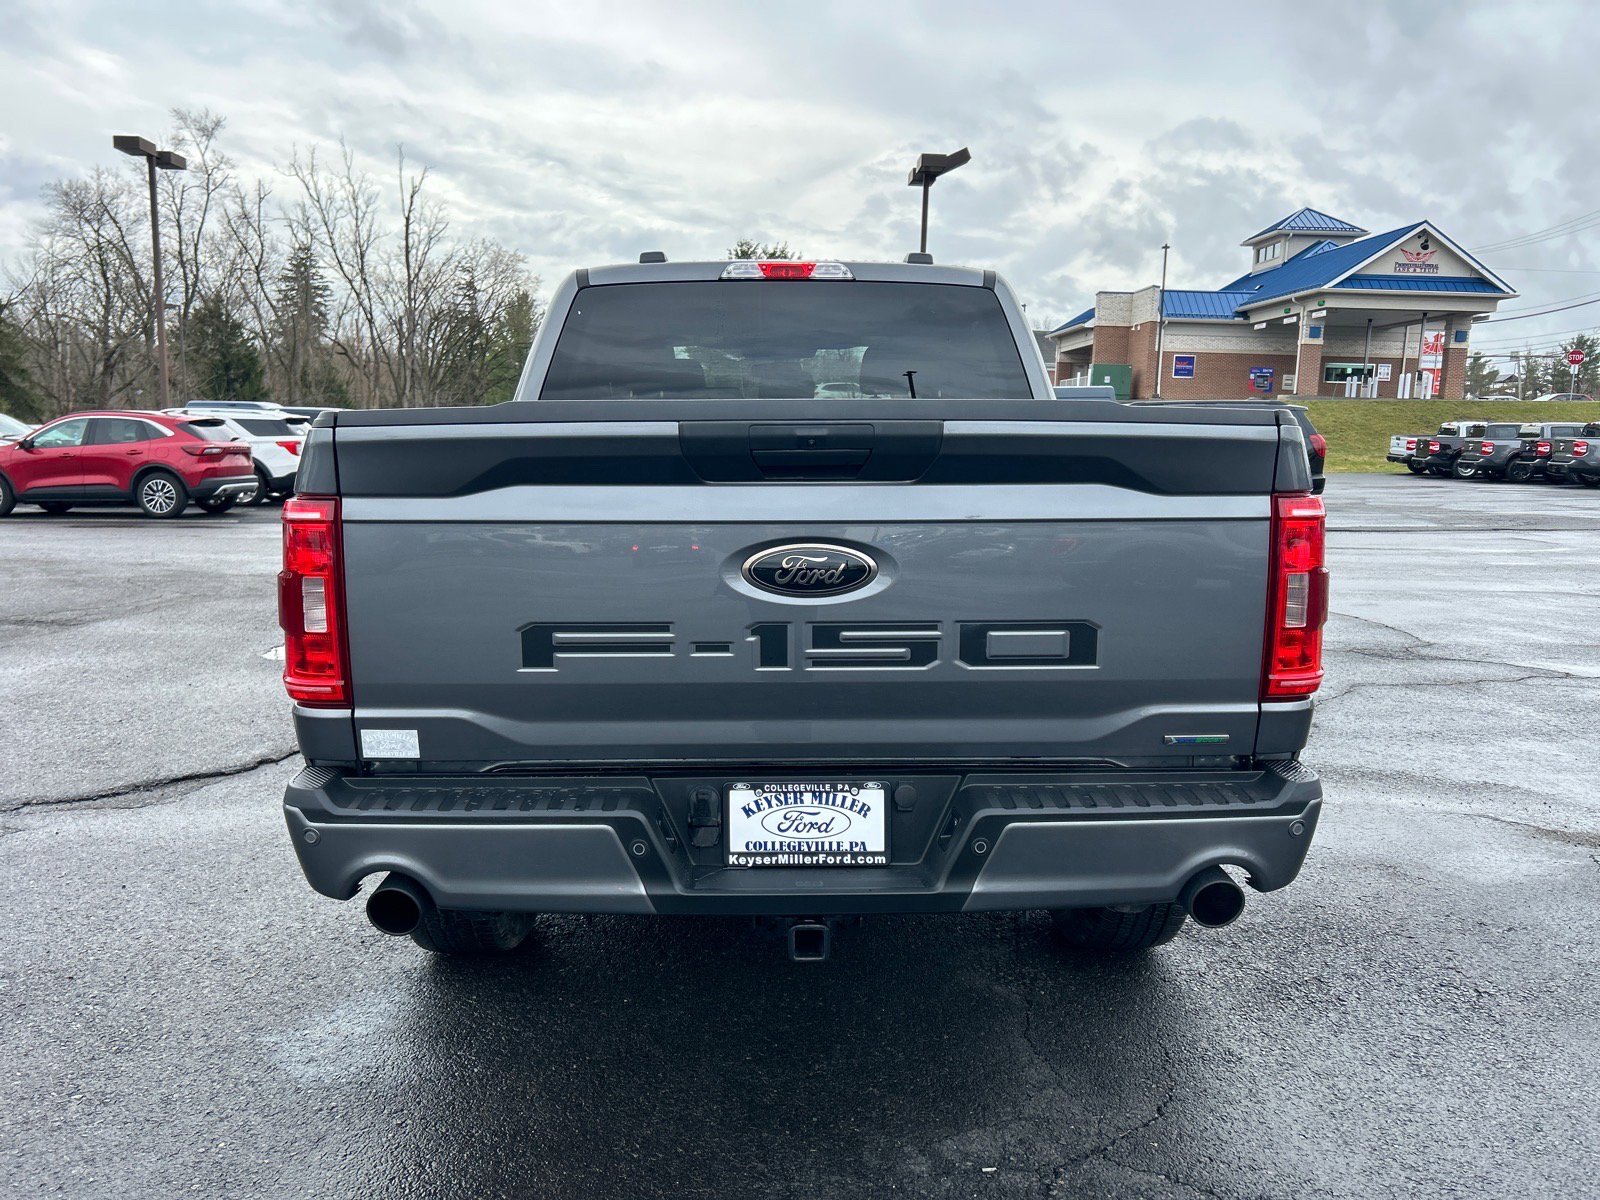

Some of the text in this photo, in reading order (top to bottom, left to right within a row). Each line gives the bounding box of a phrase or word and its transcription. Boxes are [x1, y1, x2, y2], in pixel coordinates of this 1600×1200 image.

[774, 555, 847, 585] Ford
[515, 620, 1102, 672] F-150
[764, 784, 833, 794] COLLEGEVILLE,
[741, 792, 871, 819] KEYSER MILLER
[777, 810, 835, 833] Ford
[728, 853, 886, 867] KeyserMillerFord.com
